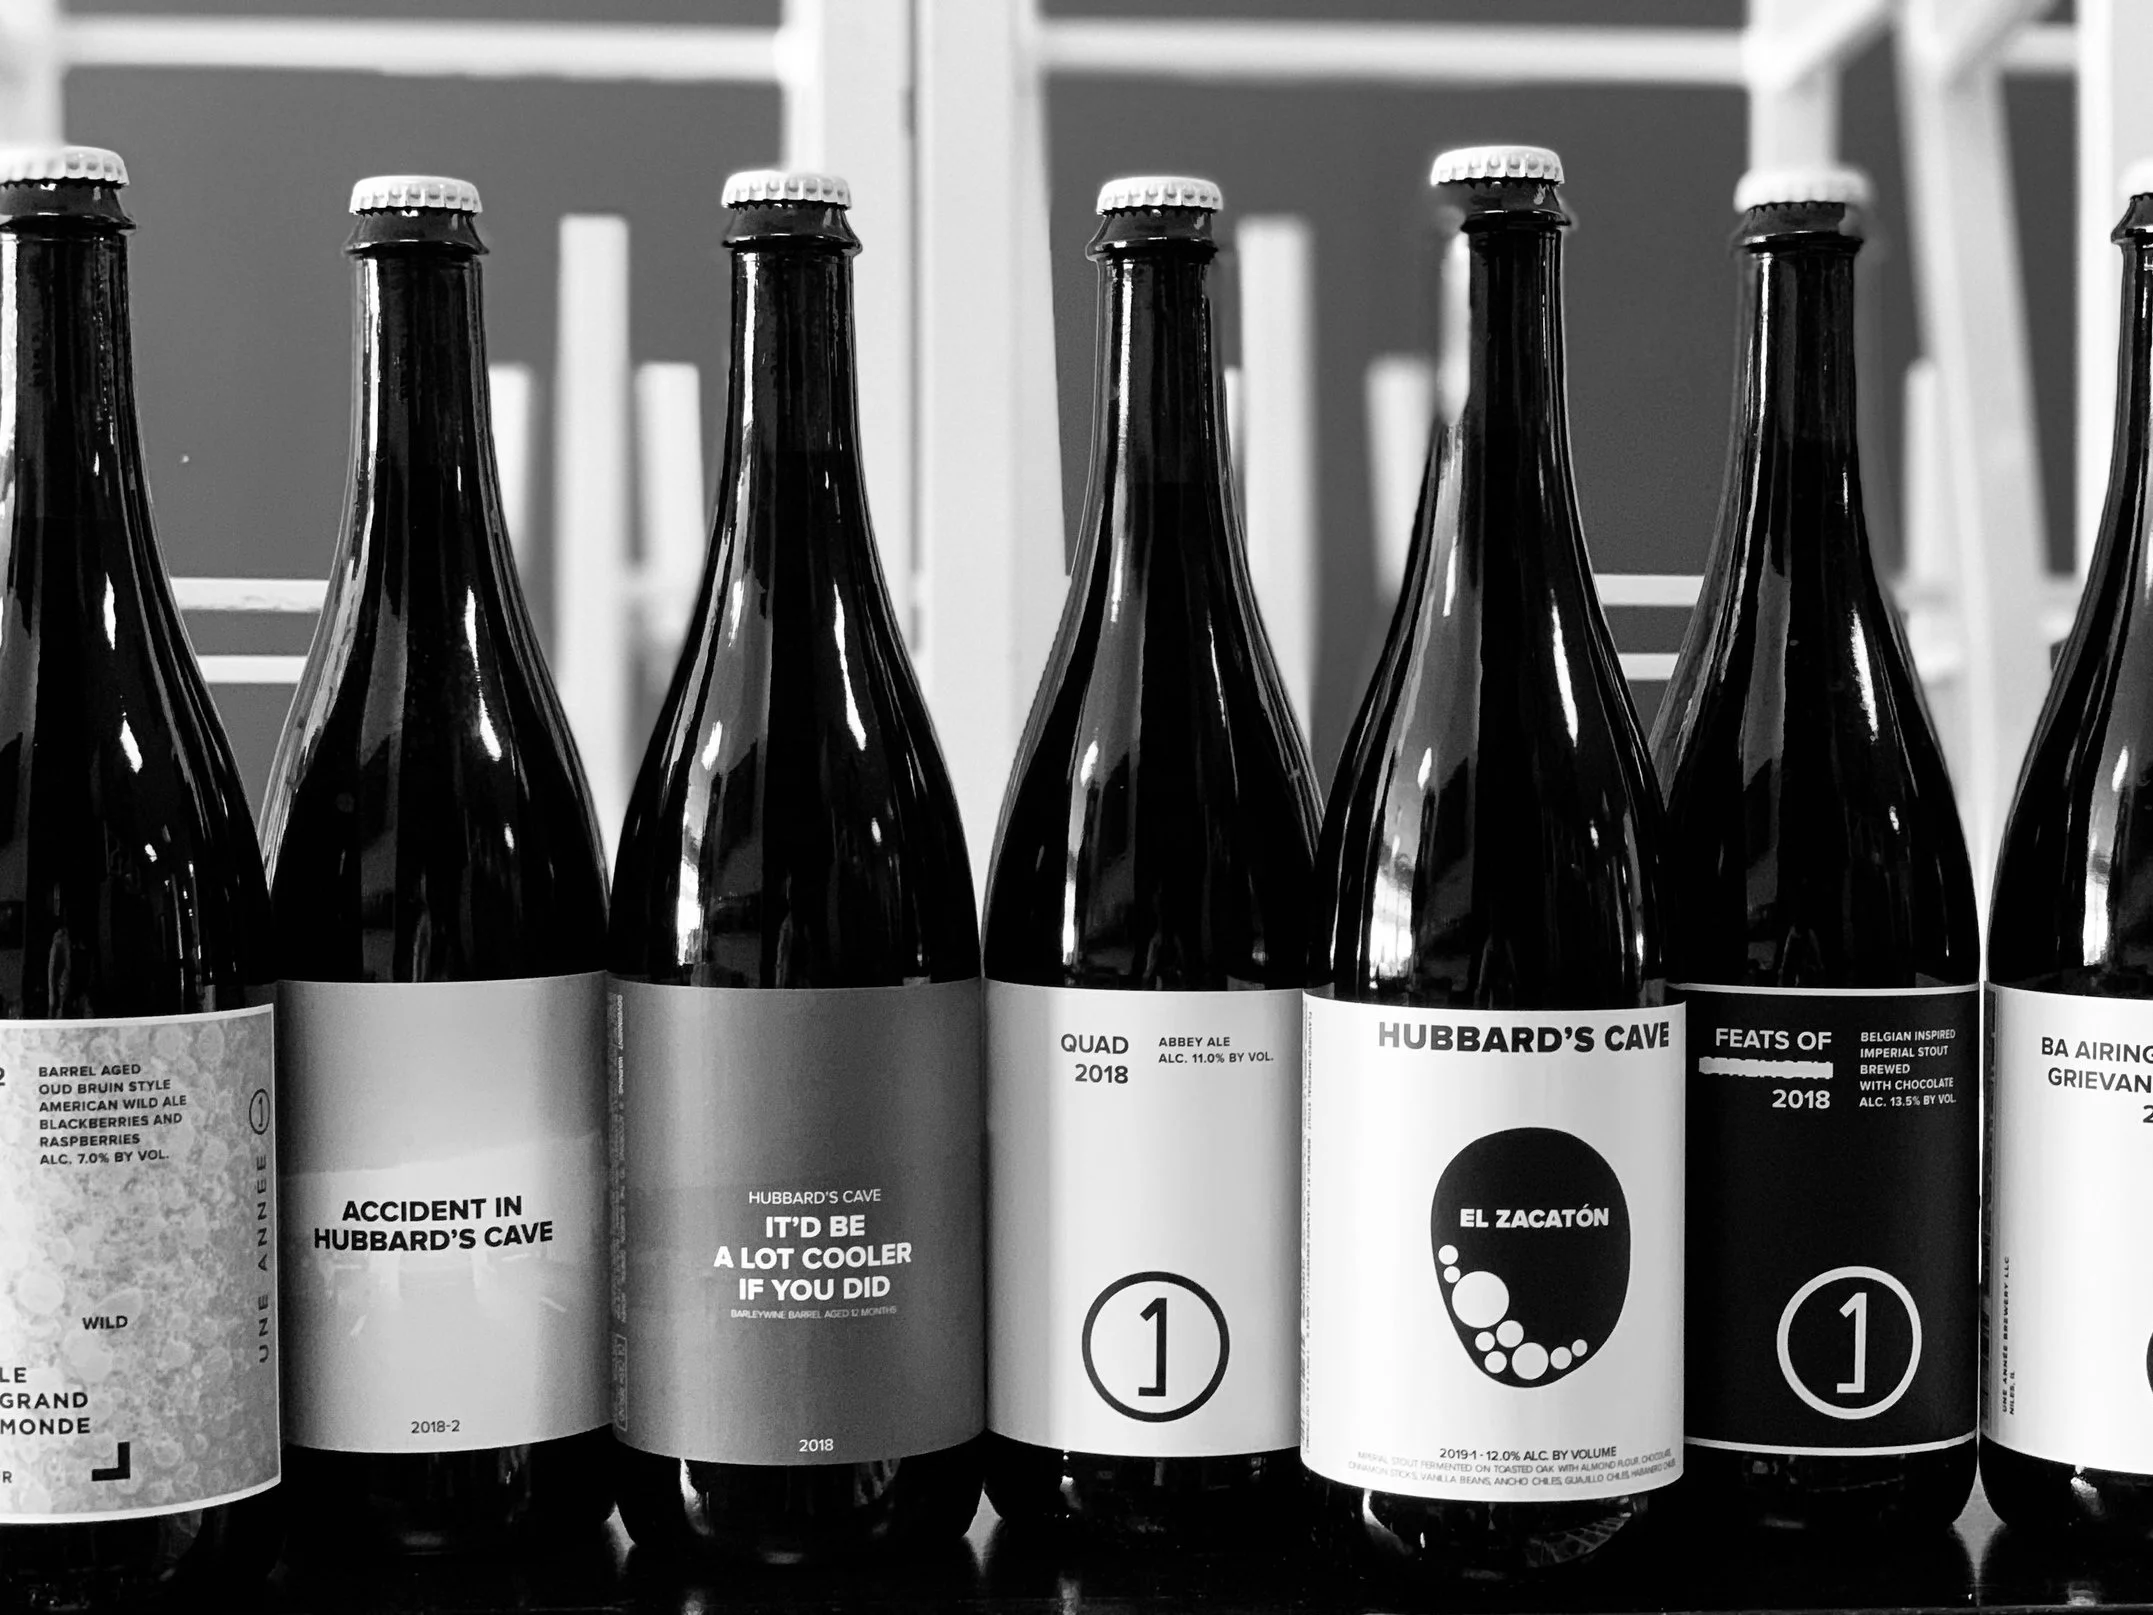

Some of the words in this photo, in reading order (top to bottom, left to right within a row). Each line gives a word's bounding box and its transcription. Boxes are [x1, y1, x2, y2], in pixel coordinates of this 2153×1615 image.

[1158, 1037, 1203, 1047] ABBEY
[1206, 1037, 1230, 1047] ALE
[1379, 1021, 1595, 1053] HUBBARD'S
[1604, 1021, 1669, 1051] CAVE
[1715, 1028, 1790, 1050] FEATS
[1797, 1031, 1832, 1050] OF
[1861, 1031, 1912, 1042] BELGIAN
[1914, 1029, 1956, 1041] INSPIRED
[1061, 1034, 1129, 1055] QUAD
[1860, 1048, 1915, 1058] IMPERIAL
[1917, 1045, 1948, 1057] STOUT
[2041, 1036, 2069, 1057] BA
[2075, 1040, 2153, 1064] AIRING
[1158, 1053, 1188, 1063] ALC.
[1192, 1053, 1225, 1063] 11.0%
[1229, 1053, 1244, 1063] BY
[1248, 1052, 1274, 1062] VOL.
[39, 1066, 96, 1078] BARREL
[101, 1064, 141, 1075] AGED
[1075, 1064, 1128, 1084] 2018
[1860, 1064, 1910, 1075] BREWED
[39, 1084, 72, 1095] OUD
[78, 1082, 124, 1094] BRUIN
[129, 1079, 171, 1092] STYLE
[1859, 1080, 1891, 1091] WITH
[1894, 1077, 1954, 1090] CHOCOLATE
[39, 1100, 118, 1112] AMERICAN
[123, 1098, 158, 1109] WILD
[162, 1096, 187, 1107] ALE
[1772, 1089, 1830, 1109] 2018
[1859, 1097, 1886, 1107] ALC.
[1890, 1095, 1921, 1107] 13.5%
[1923, 1095, 1936, 1105] BY
[1938, 1093, 1957, 1104] VOL.
[39, 1116, 149, 1130] BLACKBERRIES
[153, 1113, 182, 1124] AND
[40, 1134, 140, 1147] RASPBERRIES
[40, 1154, 72, 1165] ALC.
[78, 1152, 109, 1164] 7.0%
[114, 1151, 133, 1162] BY
[137, 1149, 169, 1161] VOL.
[749, 1190, 838, 1205] HUBBARD'S
[842, 1189, 881, 1203] CAVE
[342, 1198, 487, 1222] ACCIDENT
[495, 1195, 522, 1217] IN
[1460, 1208, 1489, 1228] EL
[1496, 1204, 1609, 1228] ZACATÓN
[765, 1216, 822, 1238] IT'D
[829, 1215, 865, 1237] BE
[314, 1228, 477, 1251] HUBBARD'S
[484, 1221, 553, 1247] CAVE
[713, 1246, 734, 1268] A
[741, 1247, 795, 1270] LOT
[802, 1242, 912, 1270] COOLER
[739, 1278, 764, 1300] IF
[771, 1278, 835, 1301] YOU
[843, 1276, 890, 1300] DID
[731, 1309, 786, 1320] BARLEYWINE
[788, 1309, 822, 1320] BARREL
[824, 1309, 849, 1318] AGED
[851, 1309, 859, 1317] 12
[861, 1306, 897, 1317] MONTHS
[82, 1315, 128, 1330] WILD
[258, 1294, 269, 1364] UNE
[0, 1367, 27, 1383] LE
[0, 1392, 89, 1409] GRAND
[0, 1417, 91, 1435] MONDE
[411, 1420, 460, 1434] 2018-2
[799, 1439, 834, 1452] 2018
[1440, 1448, 1477, 1460] 2019-1
[1486, 1450, 1521, 1461] 12.0%
[1523, 1450, 1549, 1461] ALC.
[1552, 1450, 1569, 1461] BY
[1571, 1446, 1617, 1460] VOLUME
[1421, 1460, 1471, 1472] FERMENTED
[1475, 1464, 1490, 1473] ON
[1494, 1464, 1533, 1474] TOASTED
[1536, 1464, 1554, 1474] OAK
[1558, 1464, 1579, 1473] WITH
[1581, 1461, 1616, 1472] ALMOND
[1421, 1472, 1456, 1484] VANILLA
[1494, 1477, 1528, 1486] ANCHO
[1565, 1474, 1603, 1485] GUAJILLO
